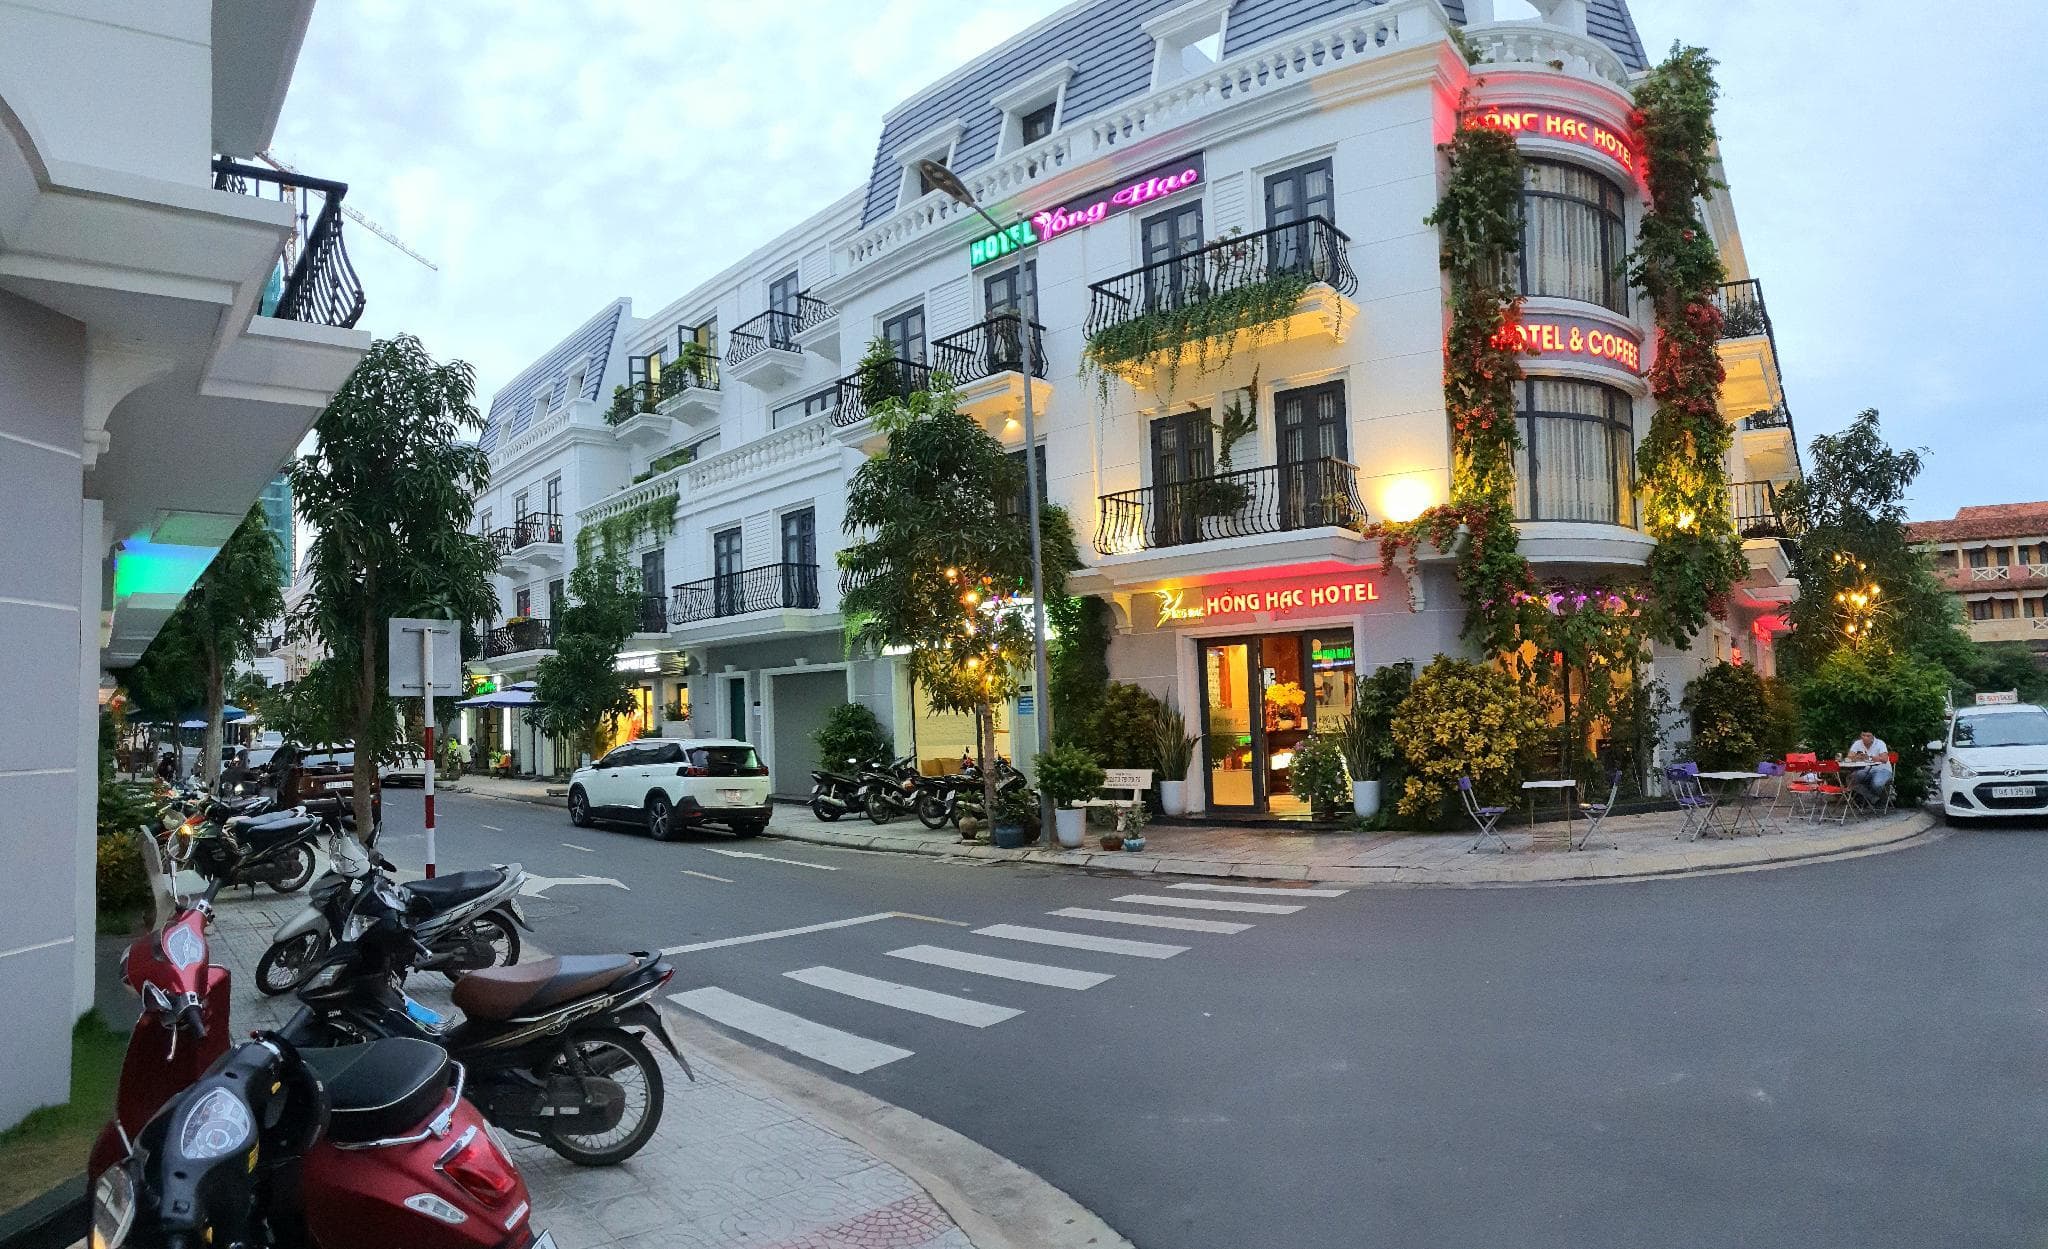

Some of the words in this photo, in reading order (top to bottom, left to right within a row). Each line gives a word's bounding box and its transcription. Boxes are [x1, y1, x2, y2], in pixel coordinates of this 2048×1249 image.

[1594, 127, 1633, 170] HOTEL
[971, 220, 1038, 267] HOTEL
[1569, 326, 1584, 352] &
[1588, 330, 1638, 370] COFFEE
[1311, 582, 1379, 607] HOTEL
